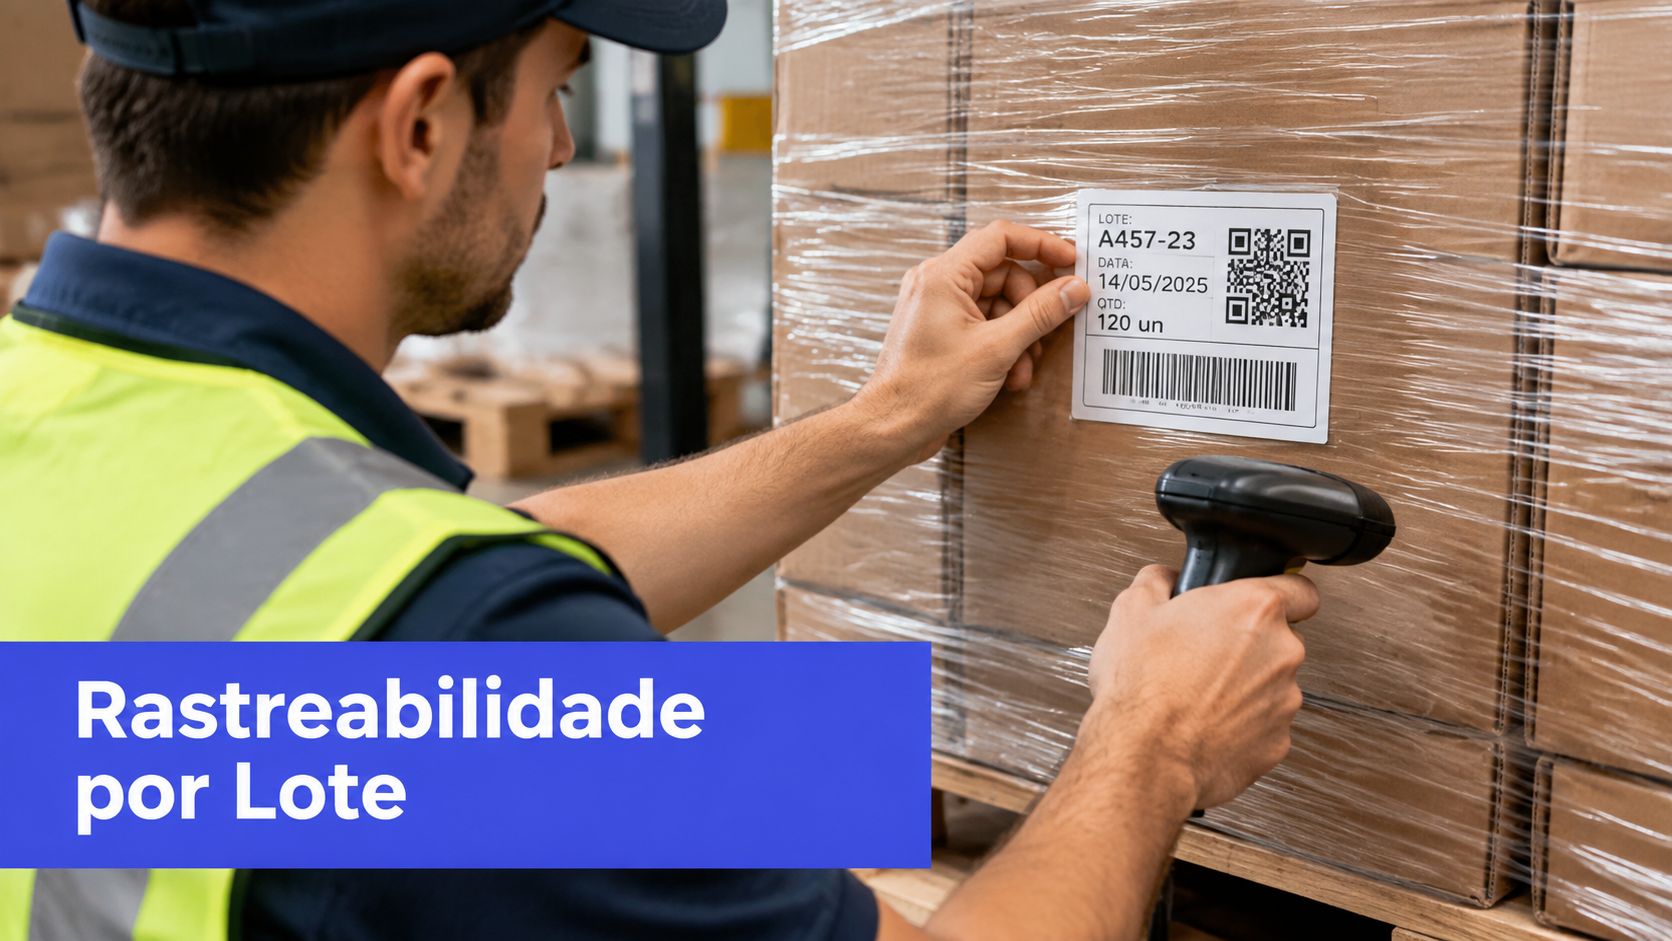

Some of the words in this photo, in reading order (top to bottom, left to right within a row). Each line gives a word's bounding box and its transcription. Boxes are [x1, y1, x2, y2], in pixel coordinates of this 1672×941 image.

[1098, 214, 1132, 225] LOTE:
[1099, 230, 1196, 250] A457-23
[1098, 257, 1133, 268] DATA:
[1099, 273, 1208, 293] 14/05/2025
[1097, 298, 1126, 310] QTD:
[1098, 313, 1130, 331] 120
[1139, 319, 1164, 333] un
